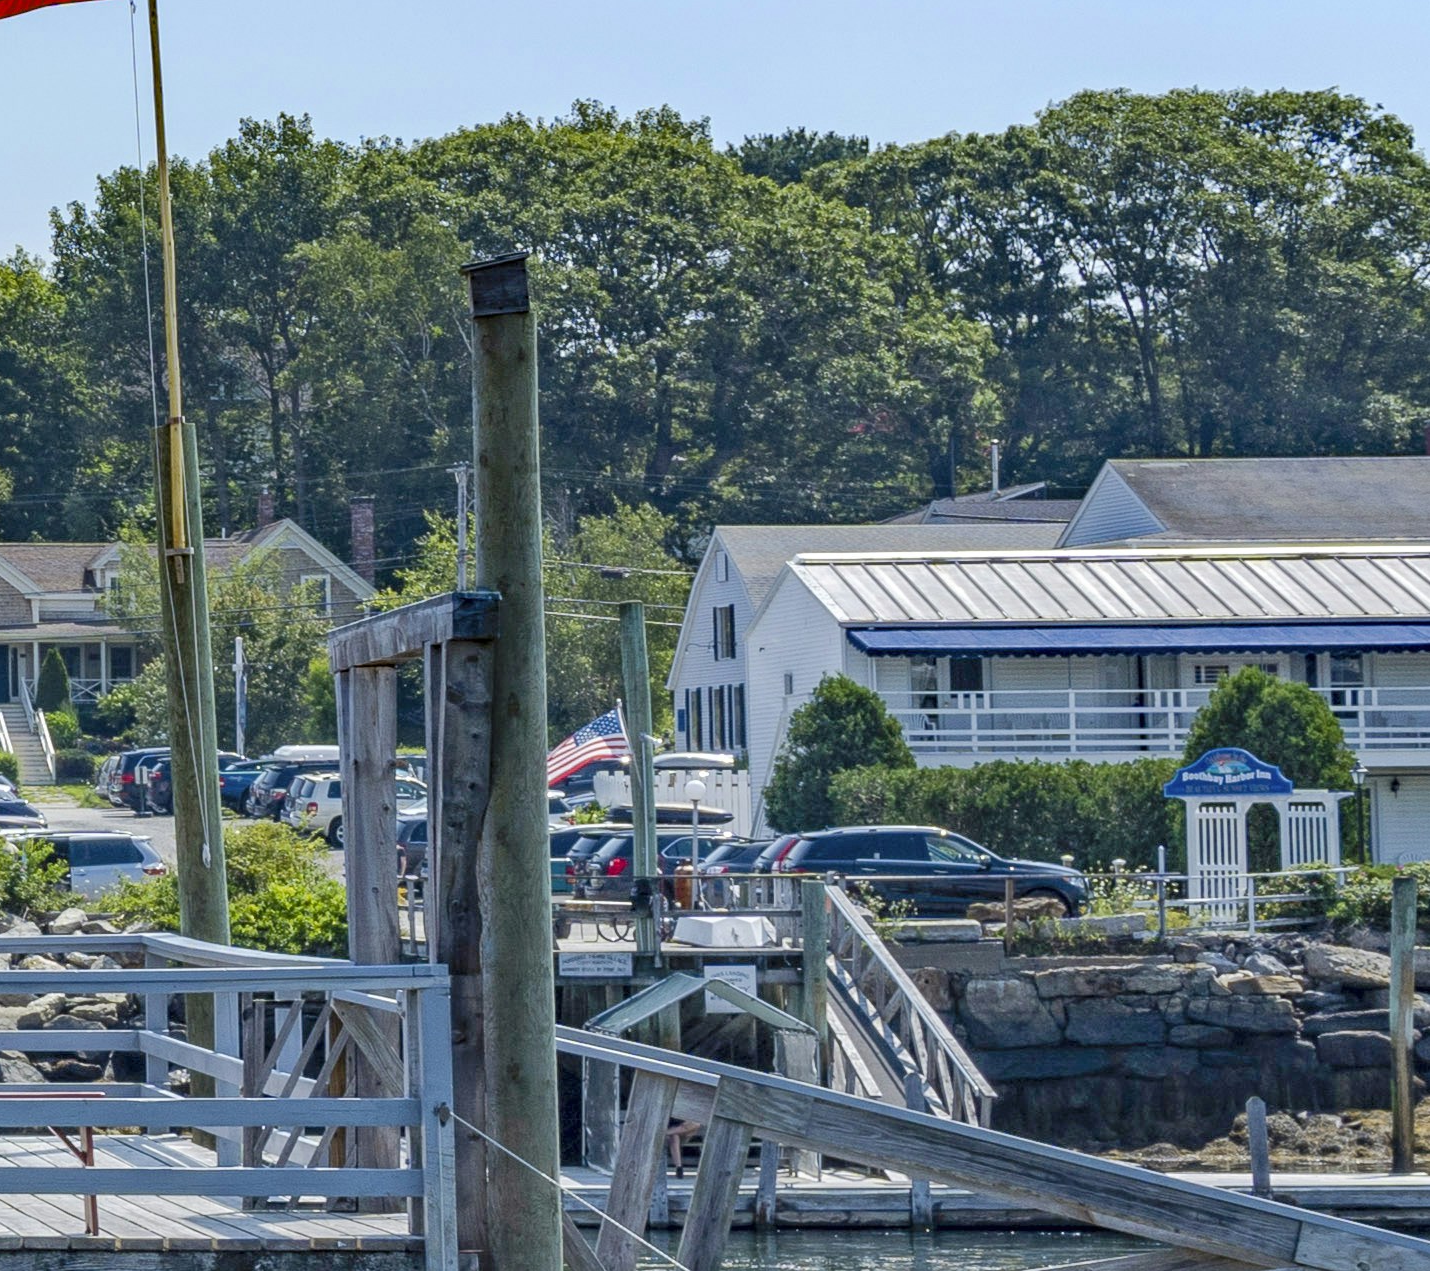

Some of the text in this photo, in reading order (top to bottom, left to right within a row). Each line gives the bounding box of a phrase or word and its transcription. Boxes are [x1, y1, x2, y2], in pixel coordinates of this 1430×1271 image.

[1182, 769, 1272, 785] Boothbay Harbor Inn
